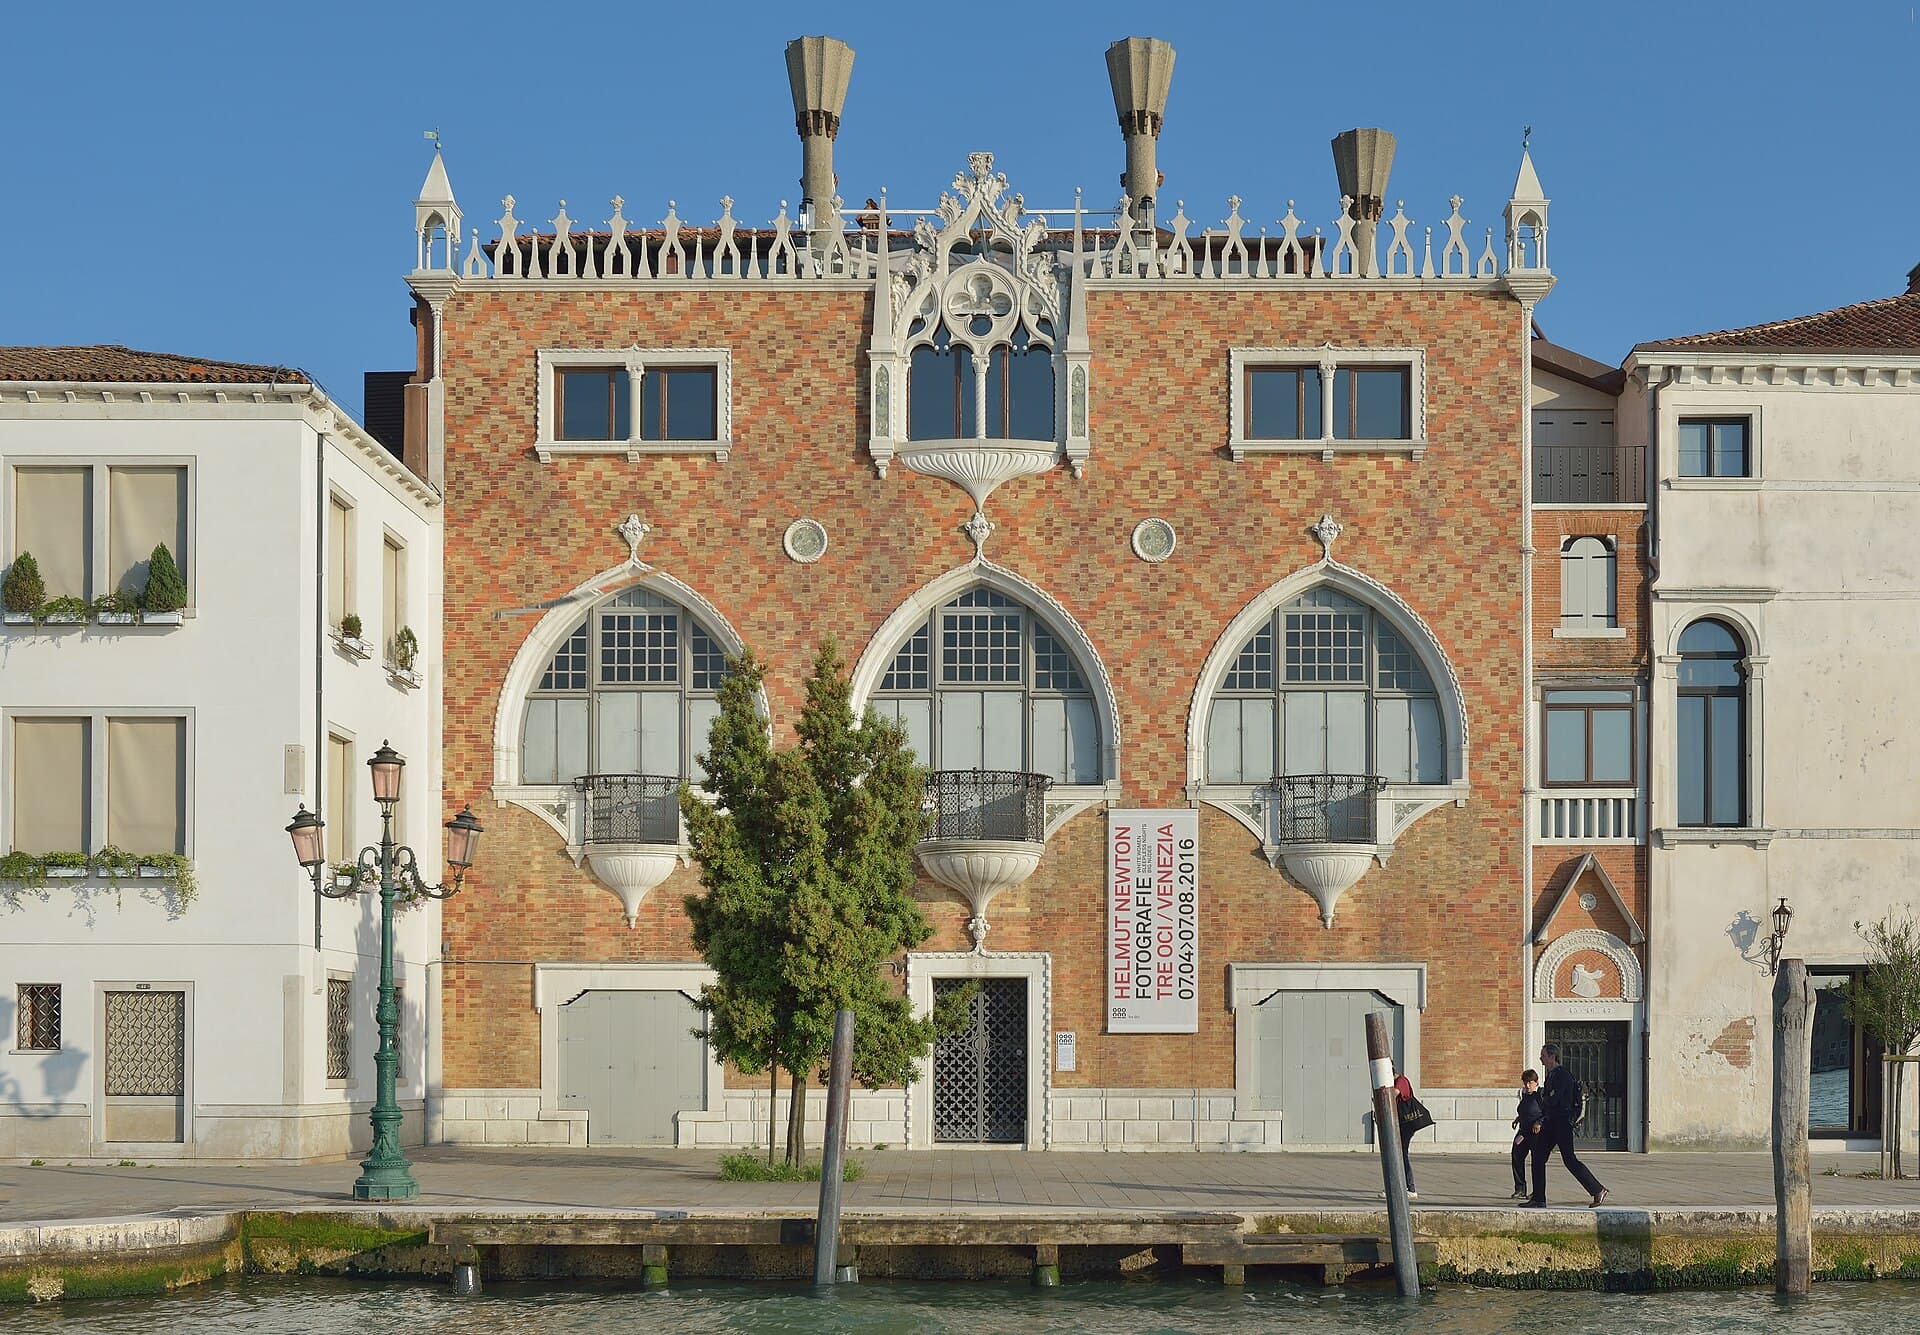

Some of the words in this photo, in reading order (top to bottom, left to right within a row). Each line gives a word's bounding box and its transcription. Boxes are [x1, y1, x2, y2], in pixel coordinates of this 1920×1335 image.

[1114, 826, 1131, 911] NEWTON
[1157, 823, 1173, 910] VENEZIA
[1114, 916, 1131, 1000] HELMUT
[1135, 876, 1151, 1000] FOTOGRAFIE
[1157, 926, 1173, 957] OCI
[1157, 962, 1173, 1001] TRE
